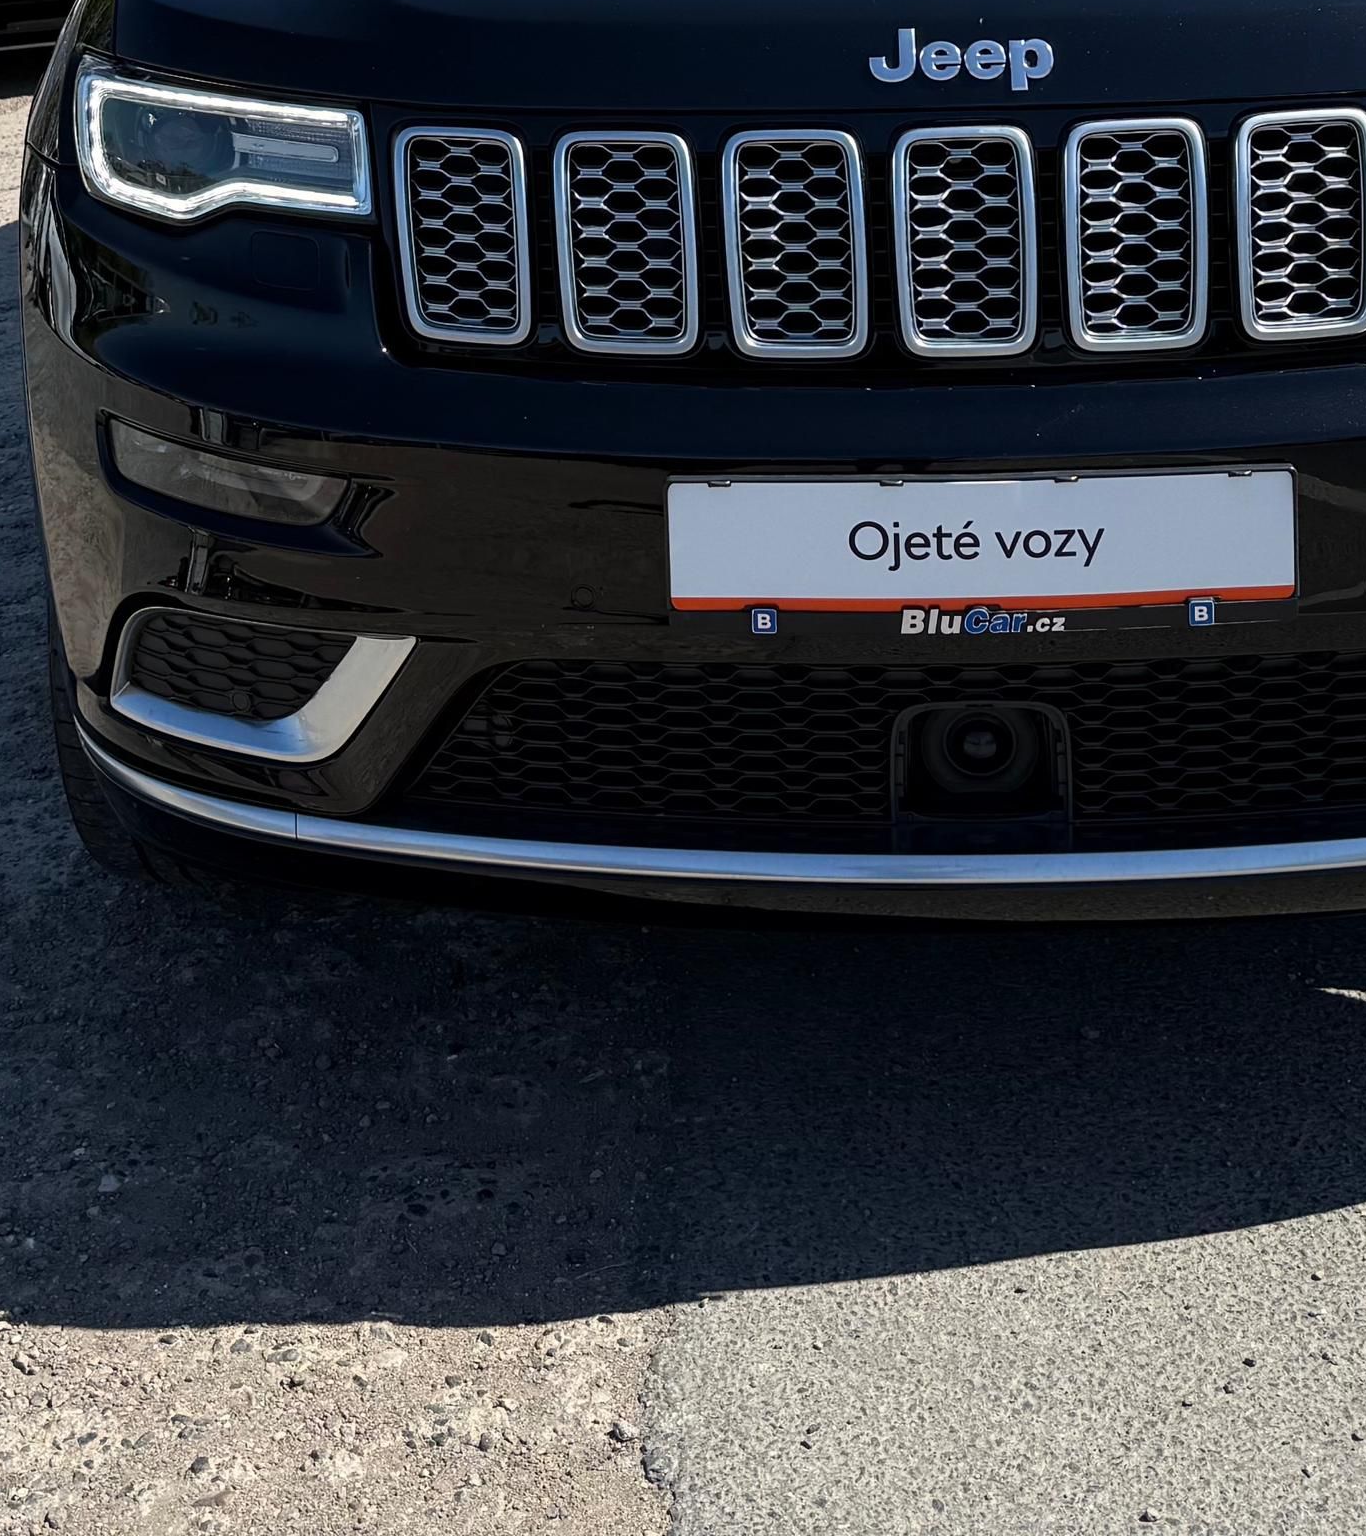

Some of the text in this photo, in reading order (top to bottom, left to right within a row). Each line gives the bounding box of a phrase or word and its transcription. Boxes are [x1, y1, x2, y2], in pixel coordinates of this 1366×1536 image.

[869, 28, 1054, 91] Jeep
[848, 520, 1105, 572] Ojeté vozy
[757, 613, 772, 629] B
[900, 606, 1066, 635] BluCar.cz
[1194, 606, 1209, 622] B
